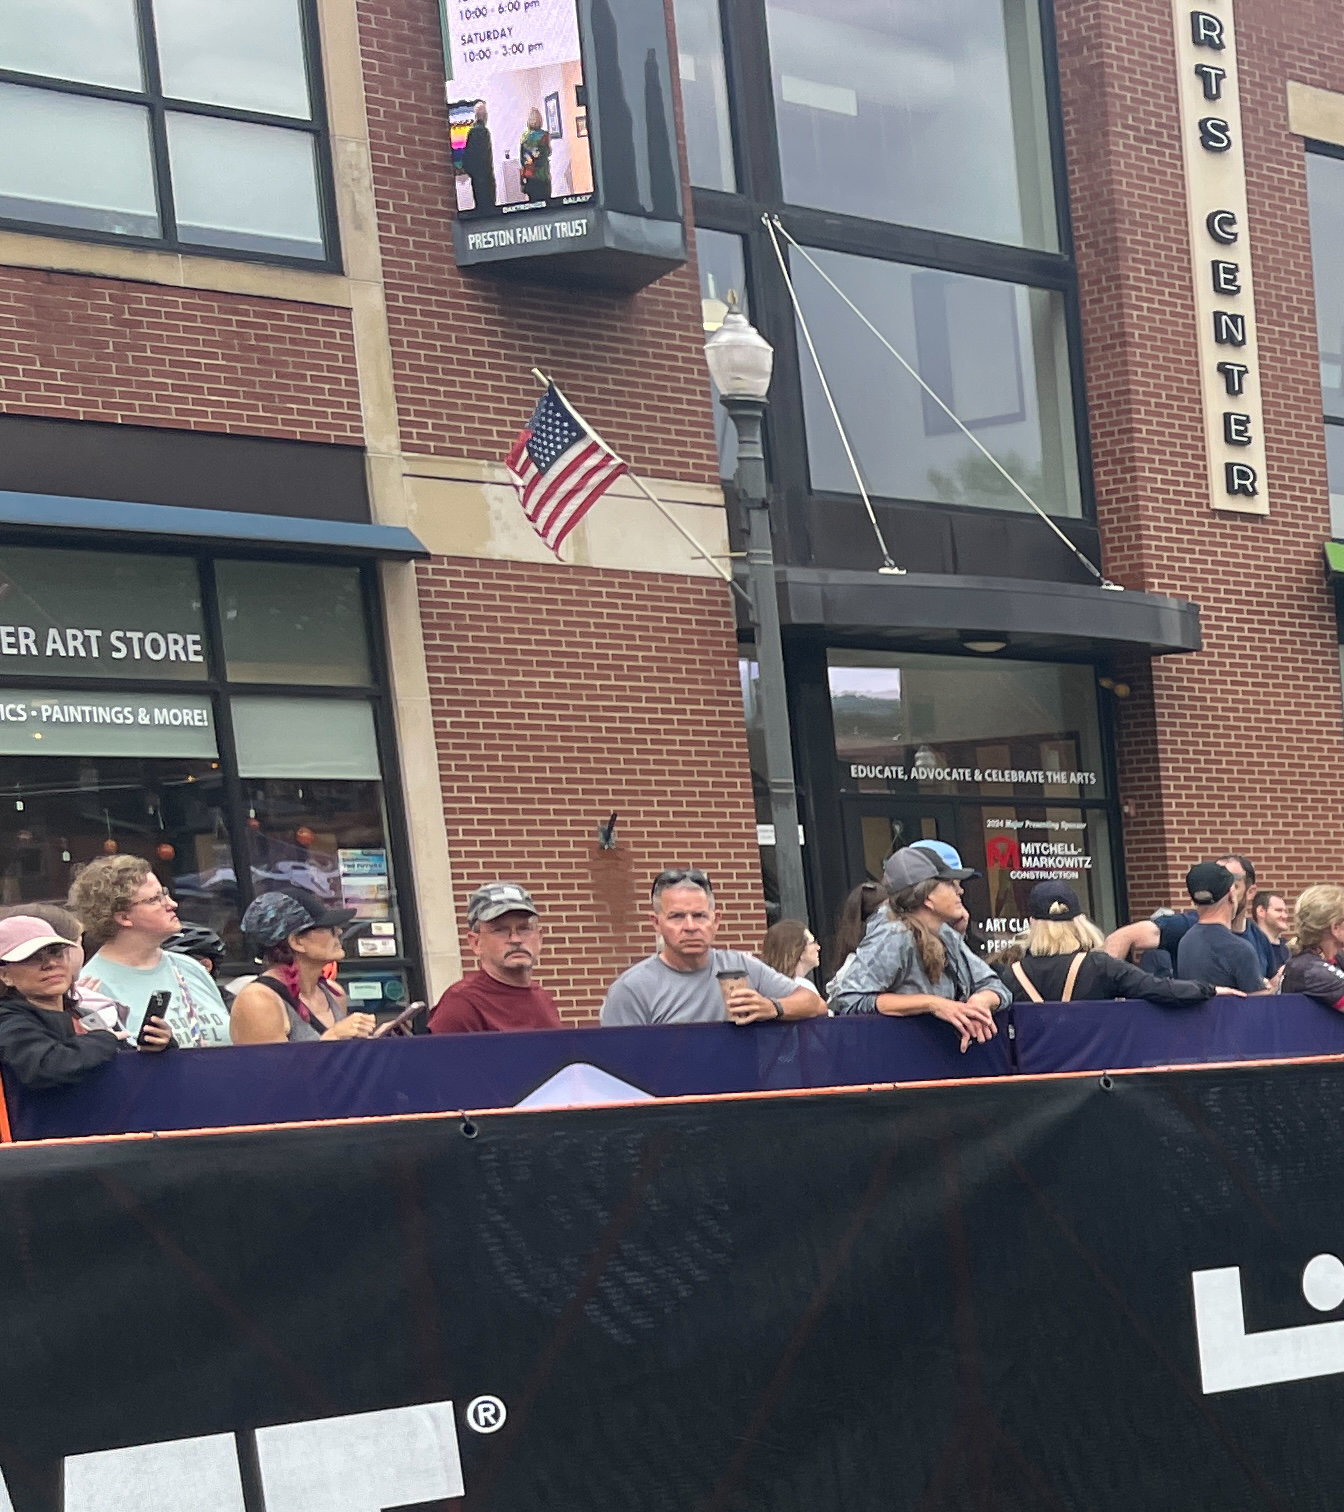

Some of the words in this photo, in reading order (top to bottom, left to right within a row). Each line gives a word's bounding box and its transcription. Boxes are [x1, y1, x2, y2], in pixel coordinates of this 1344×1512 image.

[460, 6, 488, 21] 10:00
[498, 1, 521, 14] 6:00
[461, 27, 513, 46] SATURDAY
[464, 48, 491, 63] 10:00
[502, 43, 525, 57] 3:00
[468, 229, 514, 250] PRESTON
[516, 223, 552, 244] FAMILY
[555, 219, 588, 238] TRUST
[1206, 210, 1258, 497] CENTER
[0, 626, 38, 656] ER
[46, 627, 102, 658] ART
[110, 630, 204, 662] STORE
[41, 704, 134, 724] PAINTINGS
[138, 707, 150, 725] &
[154, 708, 209, 726] MORE!
[850, 765, 908, 781] EDUCATE,
[910, 766, 972, 782] ADVOCATE
[974, 768, 983, 781] &
[984, 769, 1045, 784] CELEBRATE
[1046, 771, 1068, 784] THE
[1069, 772, 1097, 785] ARTS
[1020, 842, 1083, 856] MITCHELL-
[1022, 856, 1092, 869] MARKOWITZ
[1009, 870, 1079, 880] CONSTRUCTION
[985, 918, 1007, 932] ART
